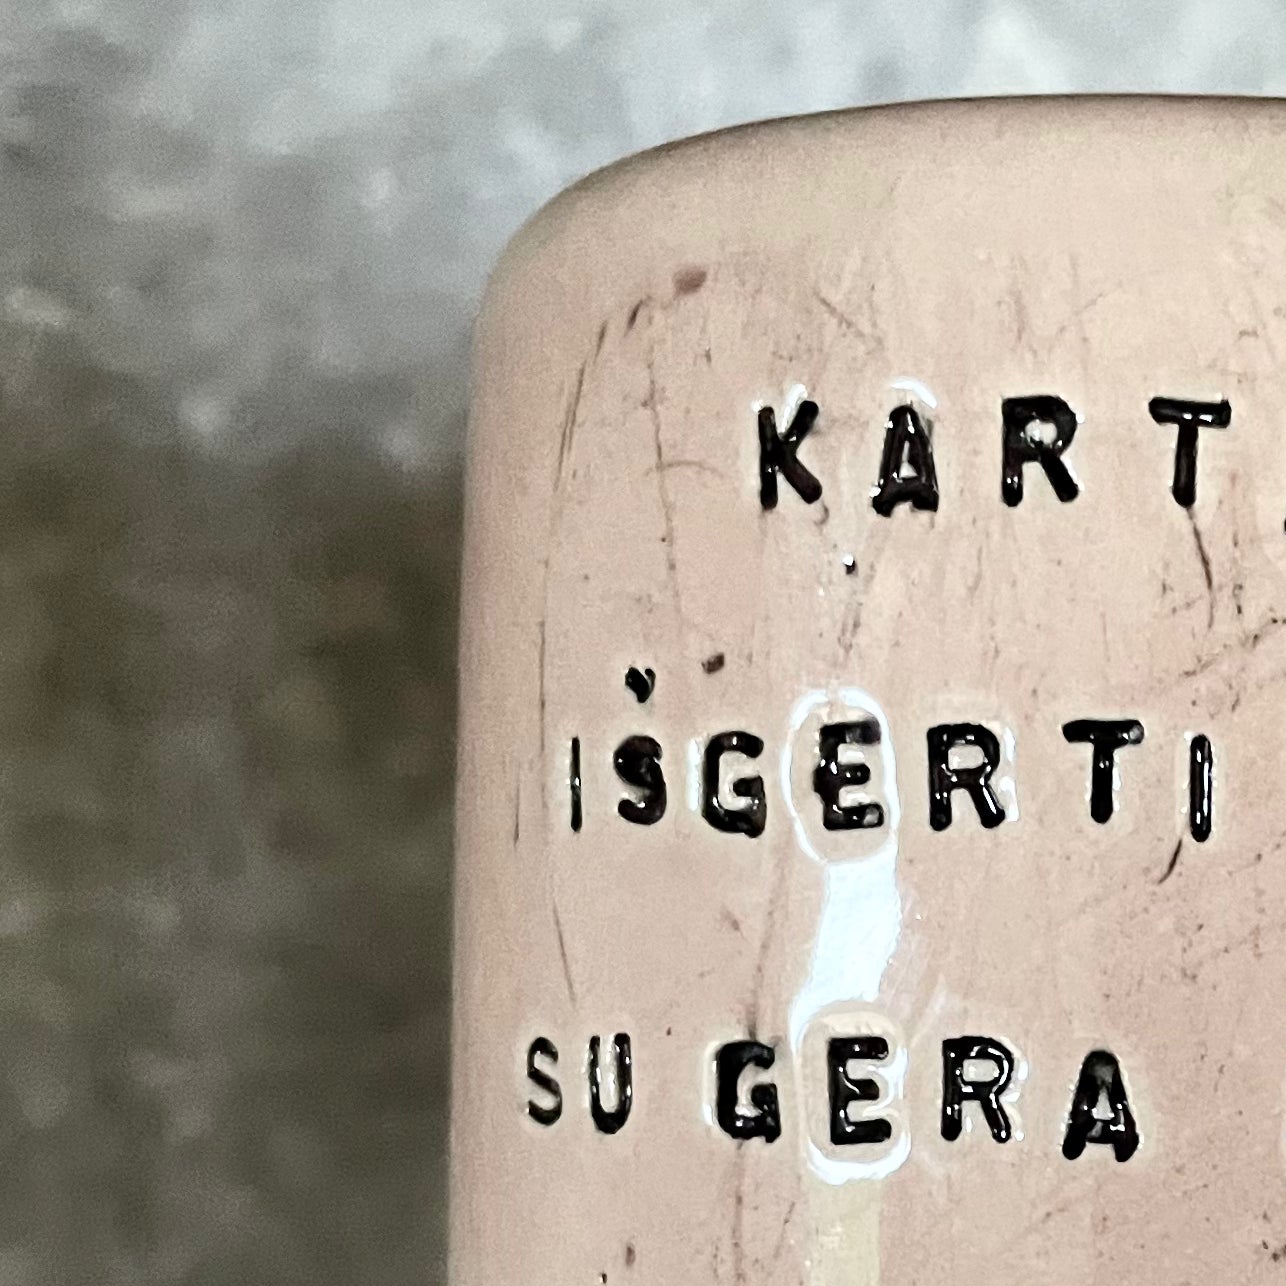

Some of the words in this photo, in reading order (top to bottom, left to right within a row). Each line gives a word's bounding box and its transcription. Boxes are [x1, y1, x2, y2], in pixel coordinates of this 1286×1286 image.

[569, 665, 1214, 842] IŠGERTI
[526, 1033, 634, 1135] SU
[714, 1035, 1140, 1162] GERA
